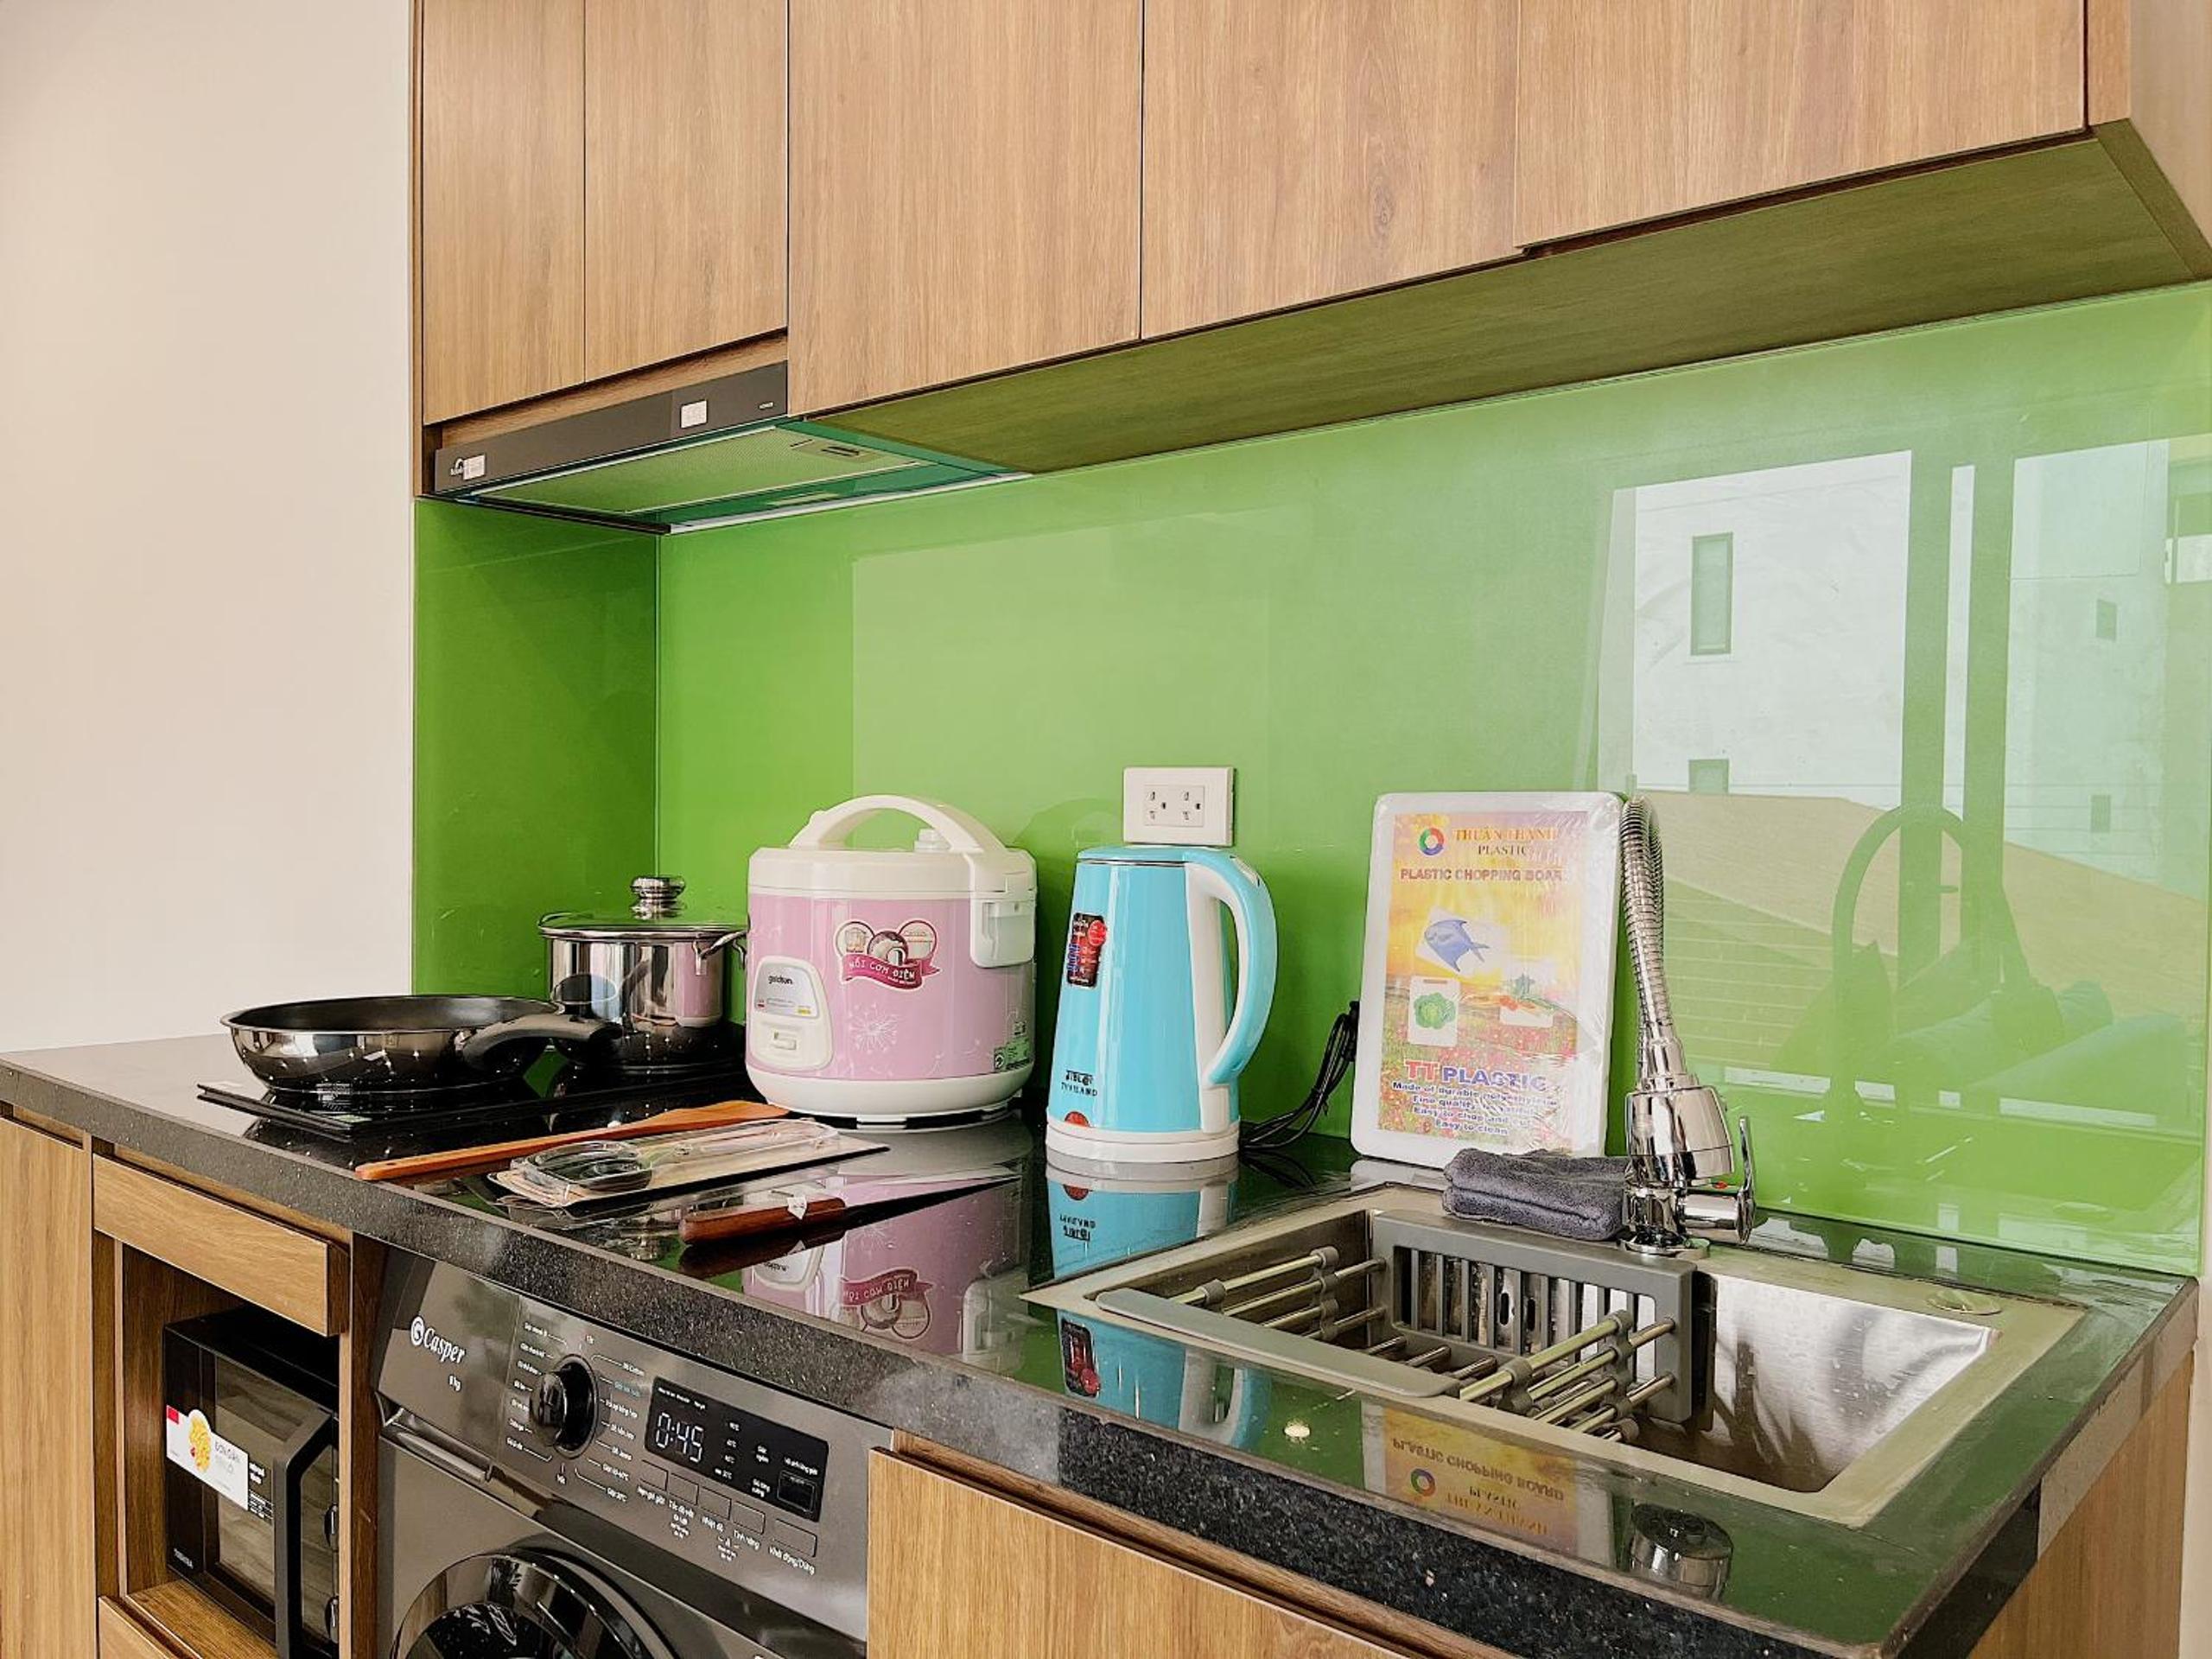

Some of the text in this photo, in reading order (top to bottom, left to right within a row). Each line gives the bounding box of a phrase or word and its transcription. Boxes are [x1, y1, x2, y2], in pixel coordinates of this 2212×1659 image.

[1400, 868, 1452, 880] PLASTIC
[1455, 868, 1522, 881] CHOPPING
[1392, 1081, 1421, 1092] Made
[423, 1327, 466, 1363] Casper
[656, 1411, 704, 1464] 0:45
